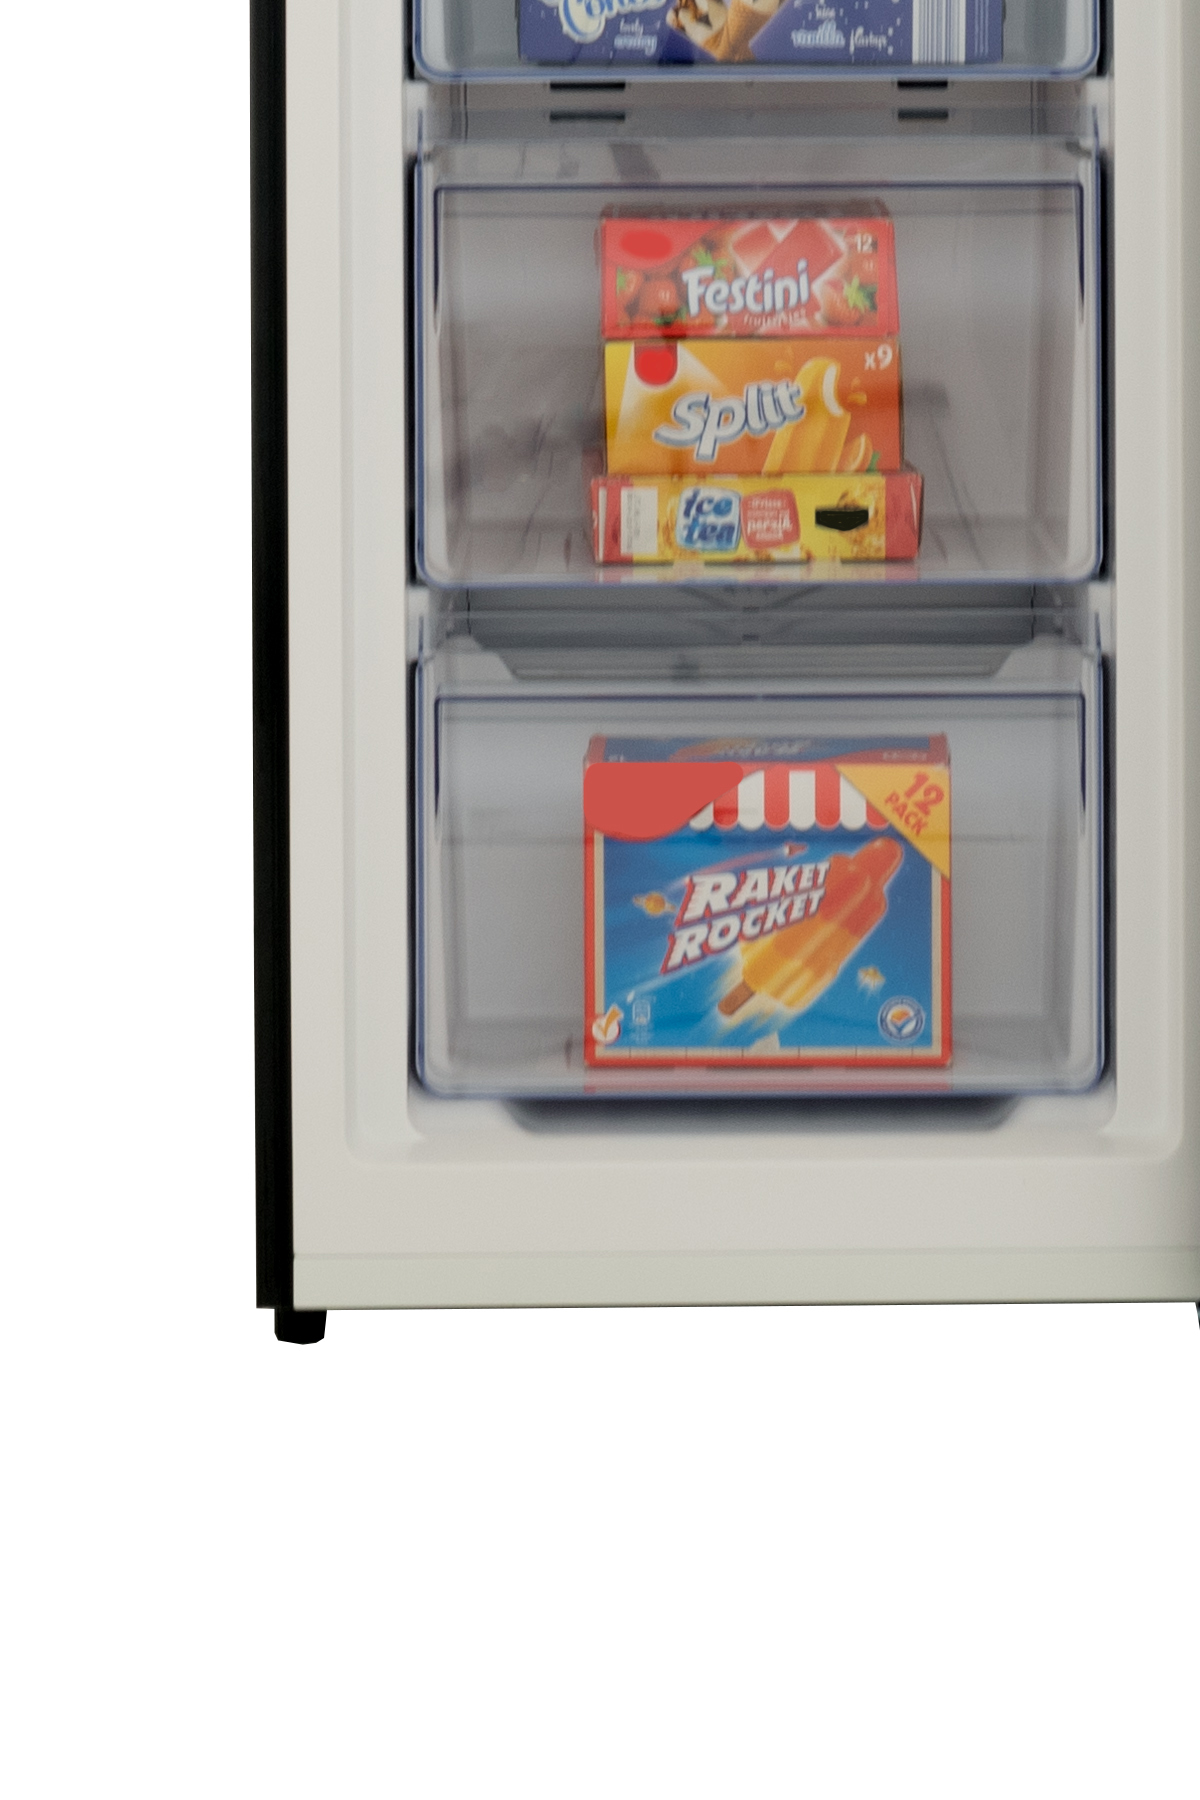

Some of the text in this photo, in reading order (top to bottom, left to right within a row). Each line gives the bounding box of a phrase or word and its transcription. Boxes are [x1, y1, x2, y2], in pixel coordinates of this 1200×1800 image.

[854, 234, 874, 252] 12
[682, 258, 810, 316] Festini
[864, 344, 893, 370] x9
[654, 381, 806, 462] Split
[884, 790, 929, 837] PACK
[904, 771, 945, 818] 12
[678, 861, 832, 928] RAKET
[660, 885, 827, 974] ROCKET
